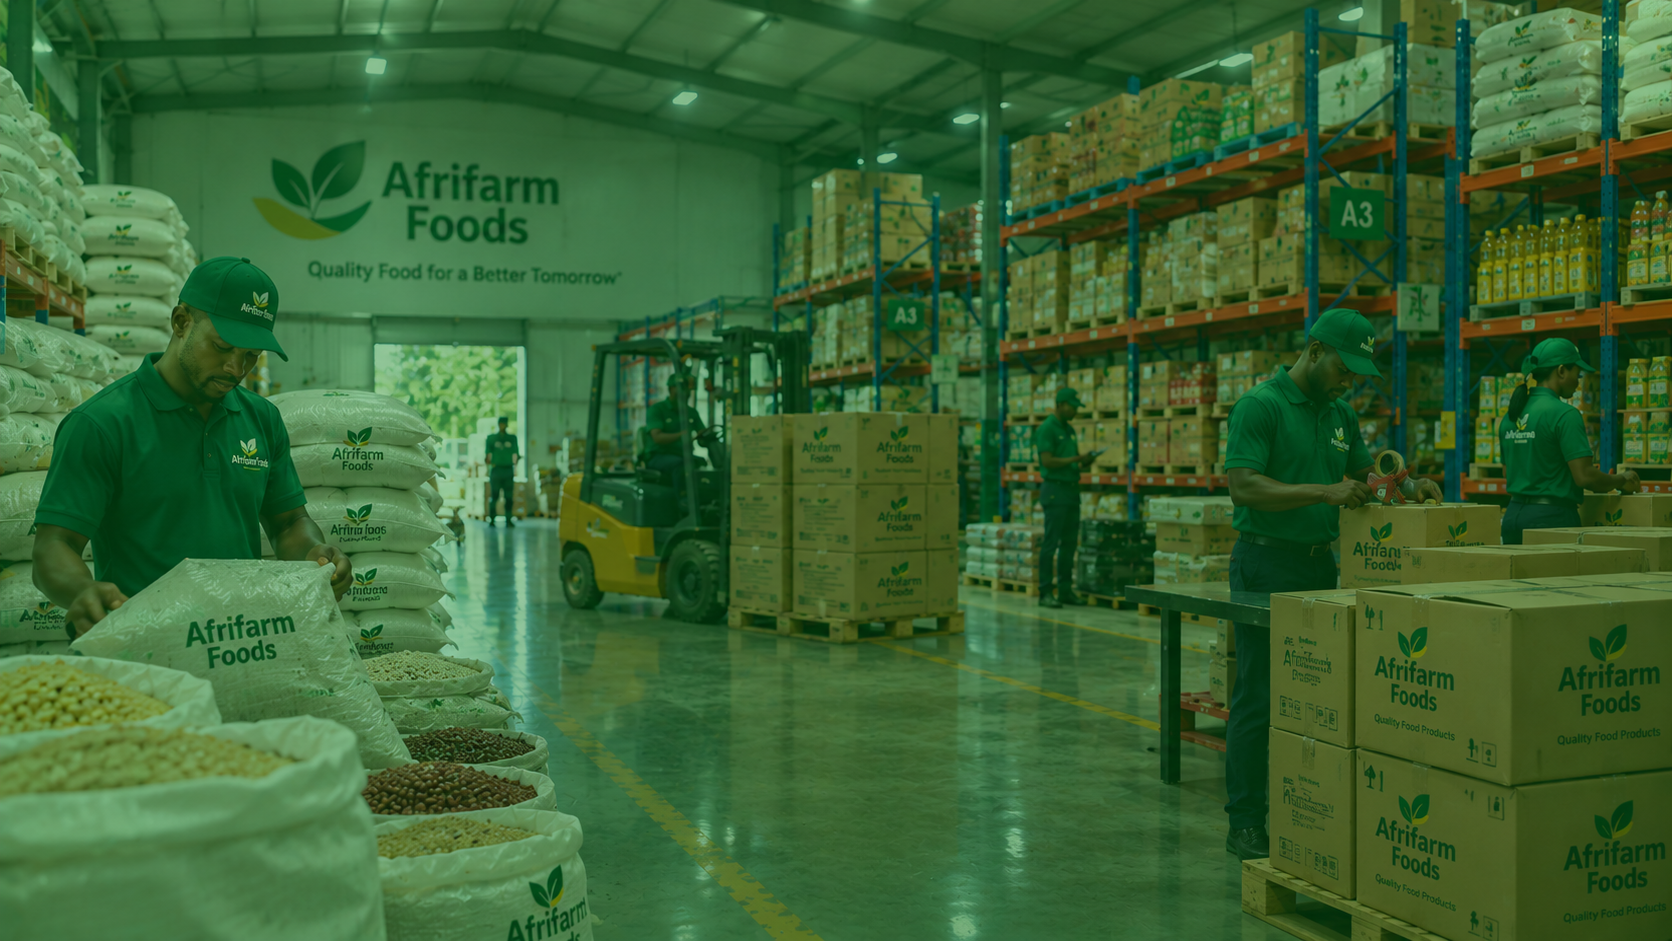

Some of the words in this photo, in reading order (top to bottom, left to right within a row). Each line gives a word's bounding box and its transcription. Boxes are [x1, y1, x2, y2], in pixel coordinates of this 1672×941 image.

[381, 160, 560, 205] Afrifarm
[406, 204, 529, 245] Foods
[1340, 200, 1374, 229] A3
[307, 260, 374, 283] Quality
[378, 263, 422, 281] Food
[427, 264, 454, 282] for
[457, 269, 468, 282] a
[473, 266, 527, 284] Better
[894, 306, 917, 325] A3
[331, 447, 384, 460] Afrifarm
[876, 441, 922, 453] Afrifarm
[342, 461, 374, 471] Foods
[185, 613, 296, 648] Afrifarm
[207, 639, 278, 669] Foods
[1374, 655, 1455, 691] Afrifarm
[1557, 662, 1661, 692] Afrifarm
[1391, 683, 1437, 712] Foods
[1581, 690, 1641, 716] Foods
[1374, 713, 1400, 729] Quality
[1401, 720, 1420, 732] Food
[1421, 724, 1456, 741] Products
[1557, 733, 1592, 746] Quality
[1595, 730, 1618, 742] Food
[1620, 727, 1661, 740] Products
[1375, 816, 1456, 862] Afrifarm
[1392, 845, 1440, 881] Foods
[1563, 840, 1666, 871] Afrifarm
[1375, 873, 1401, 892] Quality
[1402, 883, 1420, 898] Food
[1421, 891, 1457, 912] Products
[1587, 867, 1648, 894] Foods
[1563, 910, 1599, 924] Quality
[1601, 906, 1624, 919] Food
[1626, 902, 1667, 915] Products
